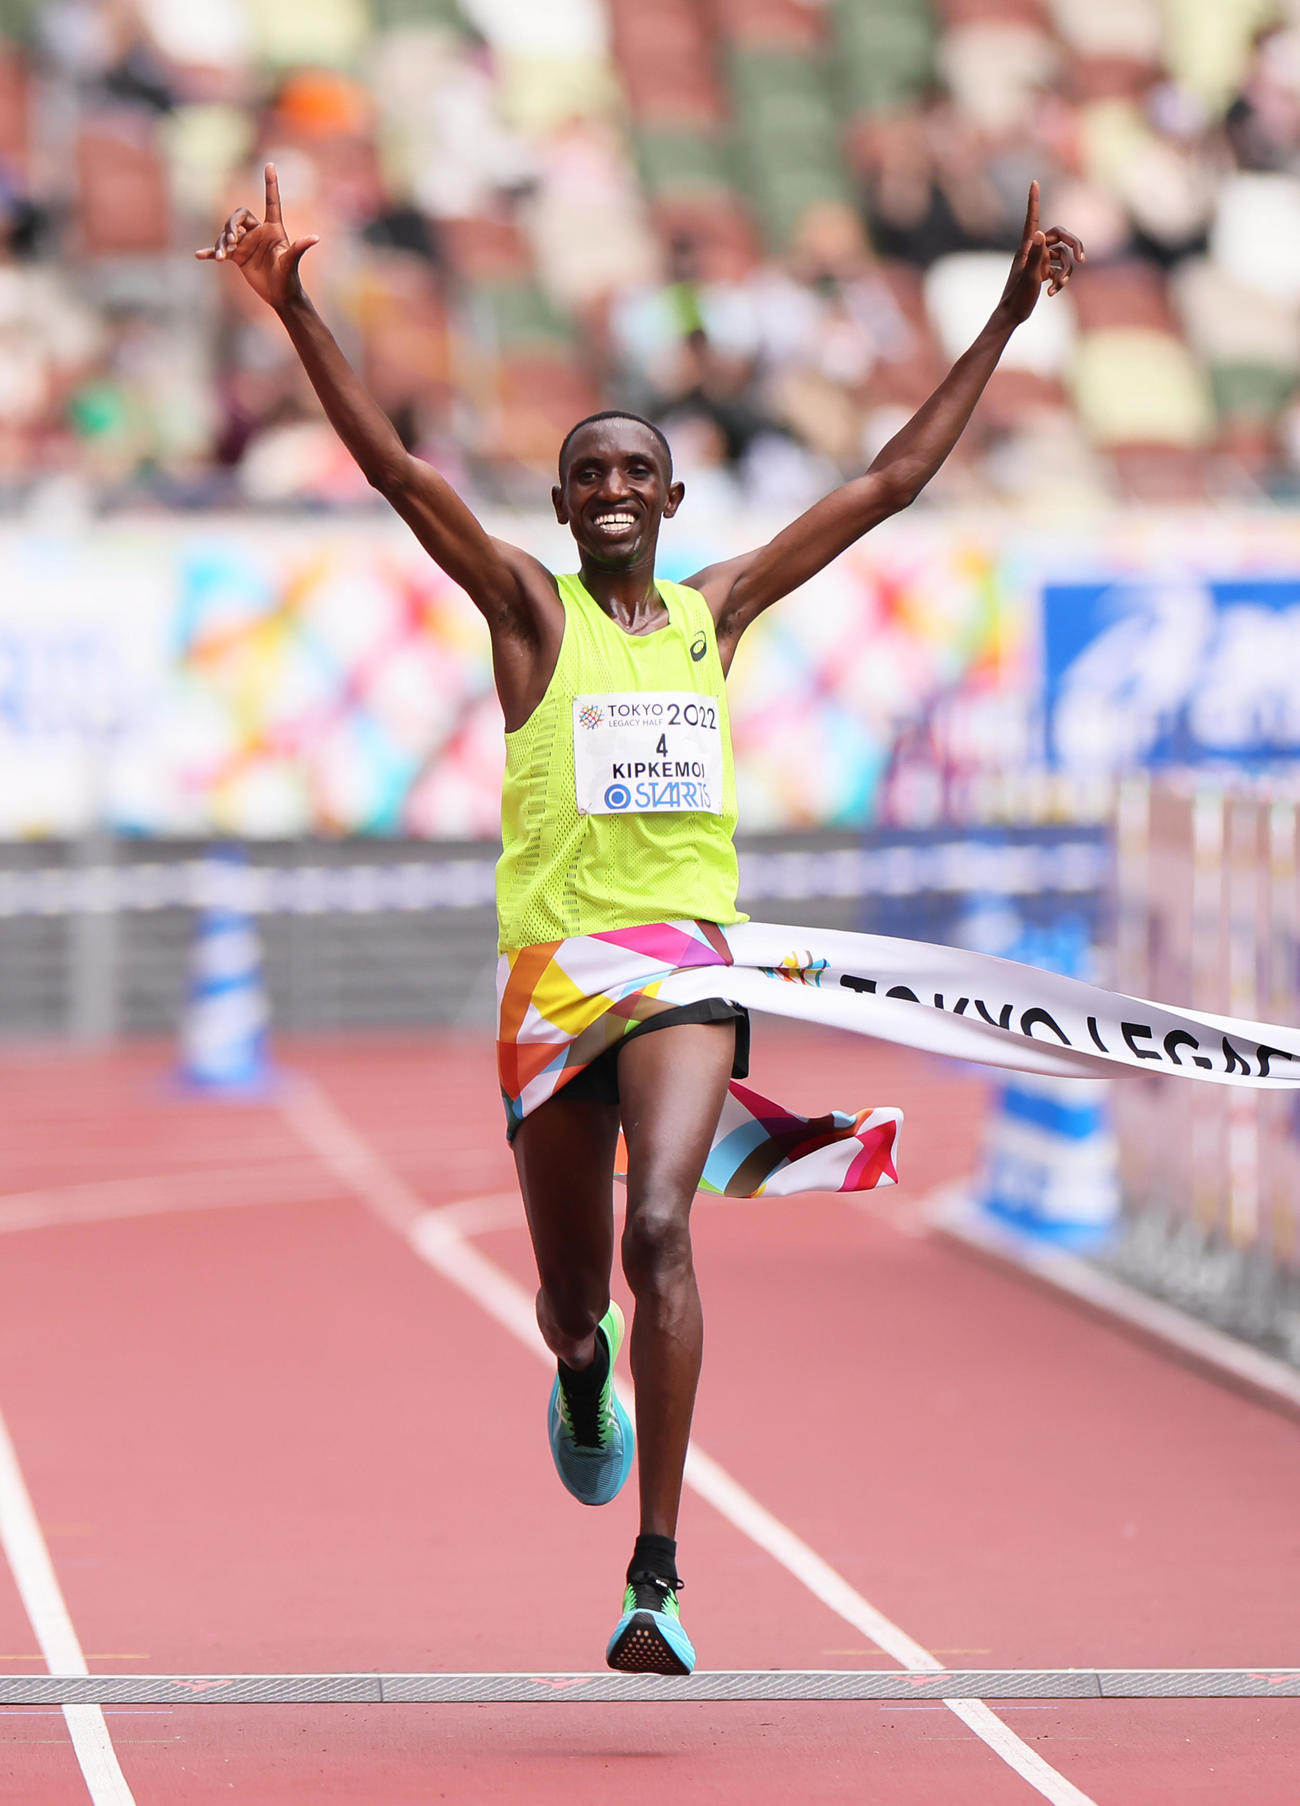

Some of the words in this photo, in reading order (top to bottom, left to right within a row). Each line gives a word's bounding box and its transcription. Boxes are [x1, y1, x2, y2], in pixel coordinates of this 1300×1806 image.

[607, 704, 664, 717] TOKYO
[666, 703, 717, 730] 2022
[608, 719, 641, 728] LEGACY
[642, 719, 663, 727] HALF
[655, 732, 669, 758] 4
[612, 761, 705, 779] KIPKEMOI
